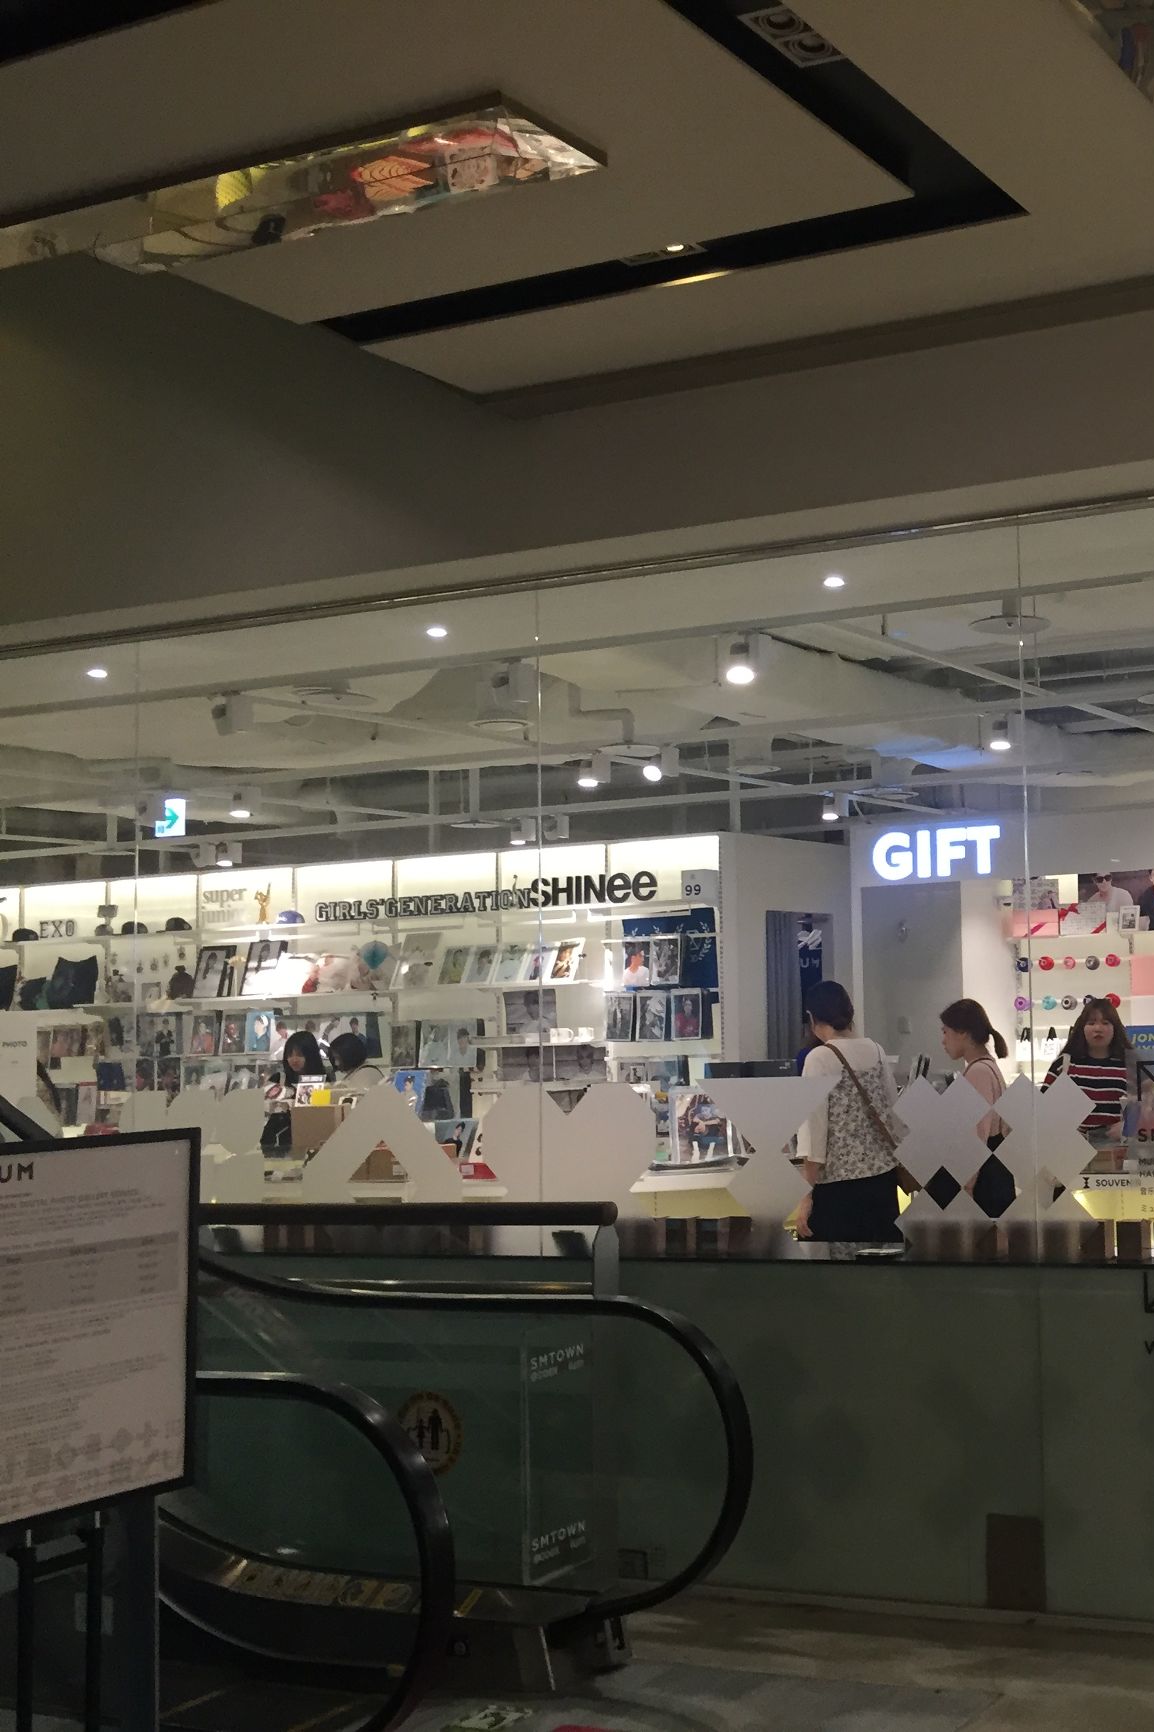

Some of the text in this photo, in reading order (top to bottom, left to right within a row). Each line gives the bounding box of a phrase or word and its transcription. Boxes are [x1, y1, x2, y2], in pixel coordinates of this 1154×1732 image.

[871, 823, 1001, 882] GIFT
[384, 888, 531, 918] GENERATION
[529, 870, 658, 908] SHINee
[685, 883, 701, 896] 99
[39, 919, 76, 938] EXO
[0, 1161, 34, 1183] UM
[530, 1344, 584, 1370] SMTOWN
[531, 1519, 586, 1552] SMTOWN
